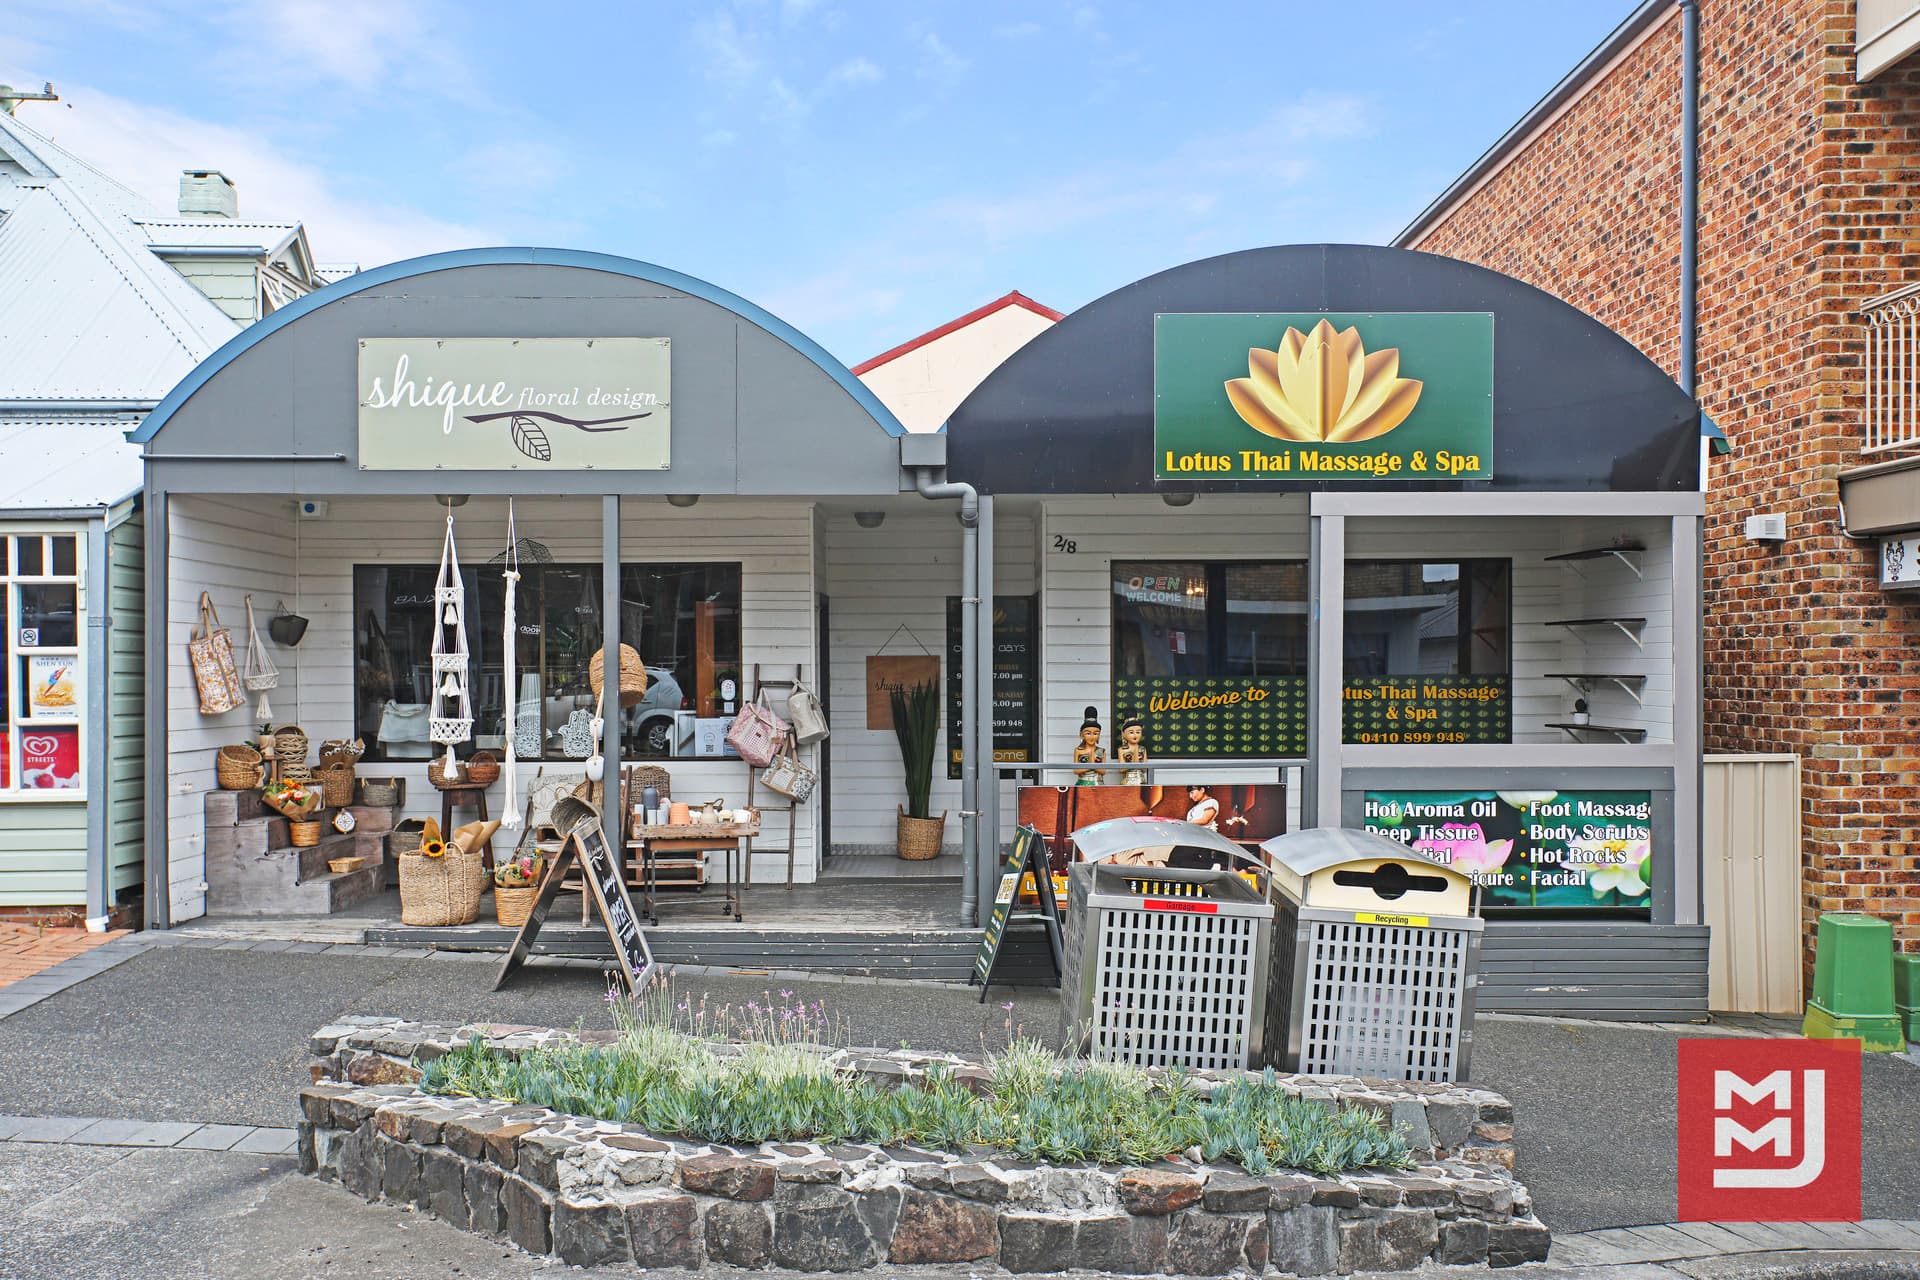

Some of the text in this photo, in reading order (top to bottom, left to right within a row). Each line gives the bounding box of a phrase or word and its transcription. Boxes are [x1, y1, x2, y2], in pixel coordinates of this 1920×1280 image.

[367, 354, 657, 435] shique floral design
[1165, 450, 1480, 476] Lotus Thai Massage & Spa
[1053, 534, 1077, 554] 2/8
[1128, 576, 1181, 591] OPEN
[1126, 591, 1182, 602] WELCOME
[1011, 673, 1023, 681] pm
[1149, 686, 1270, 713] Welcome to
[1378, 685, 1417, 700] Thai
[1423, 685, 1499, 701] Massage
[1011, 701, 1023, 709] pm
[1385, 705, 1438, 722] & Spa
[1008, 719, 1023, 727] 948
[1361, 732, 1465, 743] 0410 899 948
[1365, 801, 1497, 817] Hot Aroma Oil
[1530, 801, 1650, 819] Foot Massag
[1417, 824, 1478, 841] Tissue
[1530, 824, 1649, 843] Body Scrubs
[1530, 847, 1627, 863] Hot Rocks
[1530, 869, 1586, 886] Facial
[1166, 901, 1196, 911] Garbage
[1375, 914, 1409, 925] Recycling
